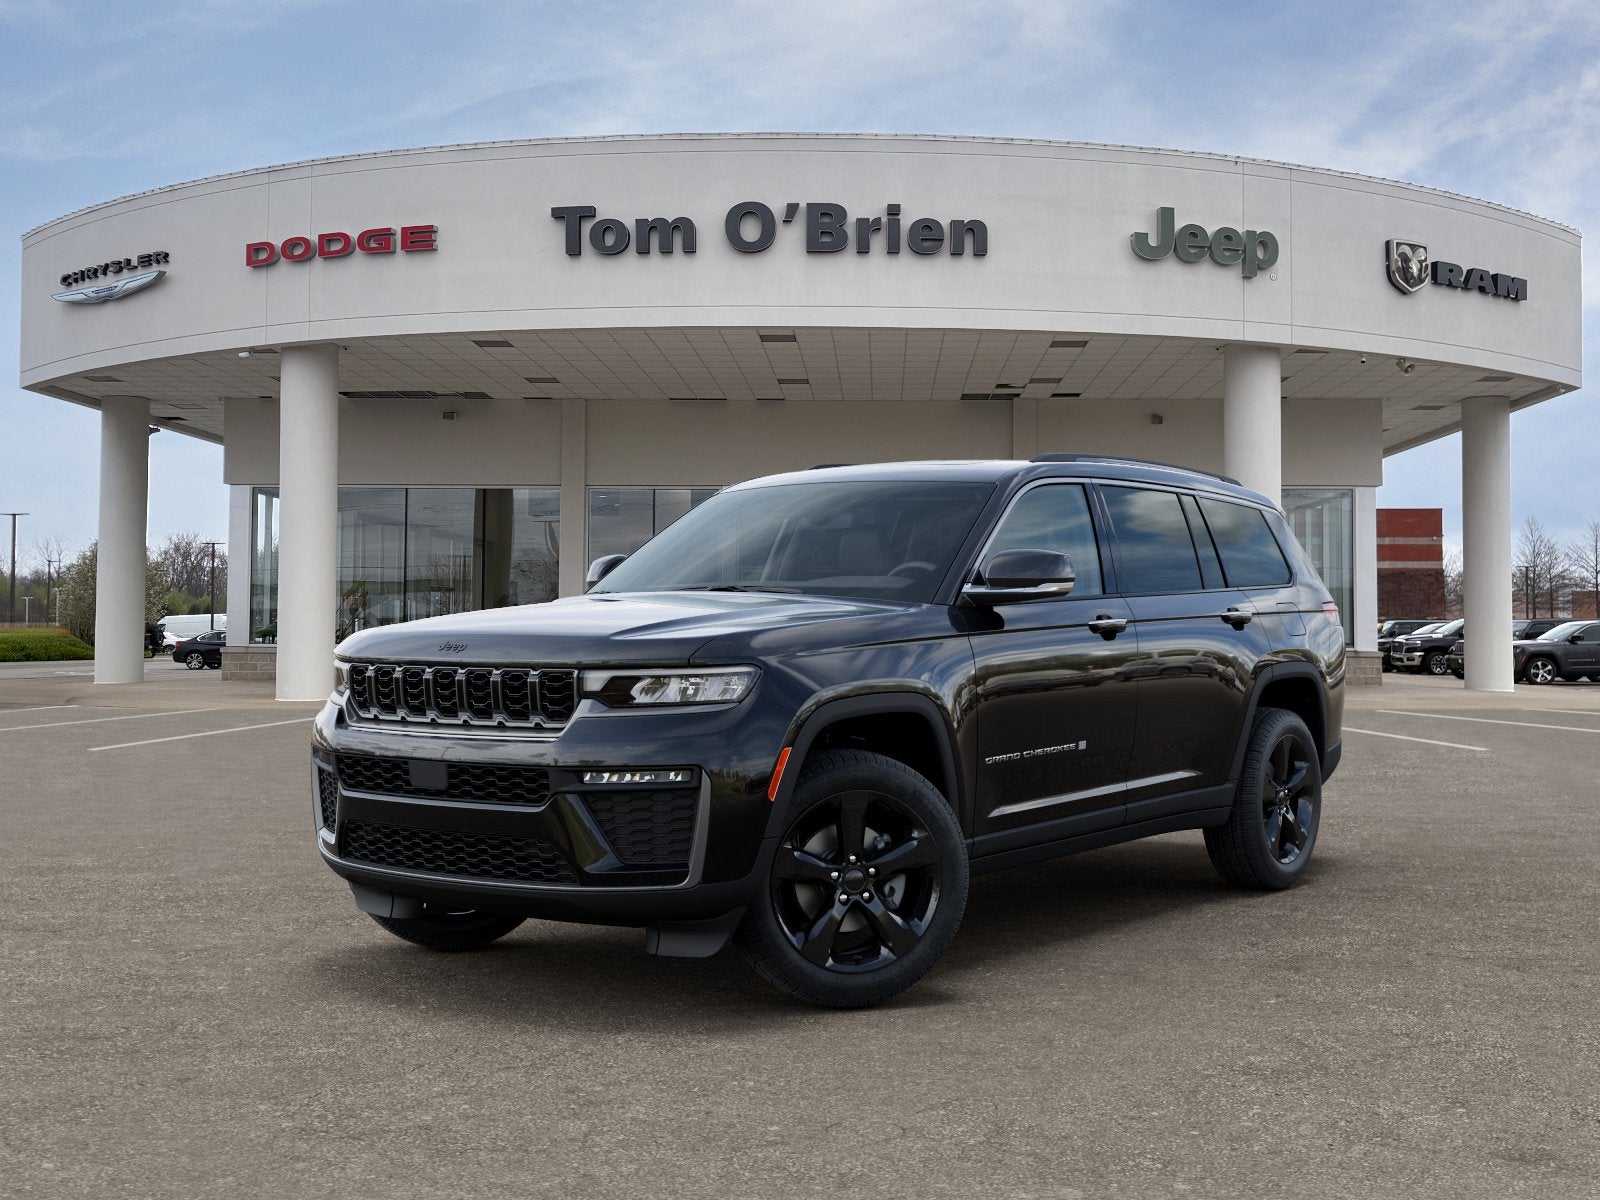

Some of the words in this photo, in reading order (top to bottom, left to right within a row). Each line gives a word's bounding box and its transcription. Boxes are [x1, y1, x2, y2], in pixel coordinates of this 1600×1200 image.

[246, 224, 439, 268] DODGE
[551, 205, 697, 256] Tom
[725, 201, 988, 256] O'Brien
[1131, 207, 1279, 278] Jeep
[60, 251, 170, 287] CHRYSLER
[1431, 261, 1528, 302] RAM
[438, 641, 468, 653] Jeep
[985, 752, 1021, 764] GRAND
[1022, 743, 1077, 758] CHEROKEE
